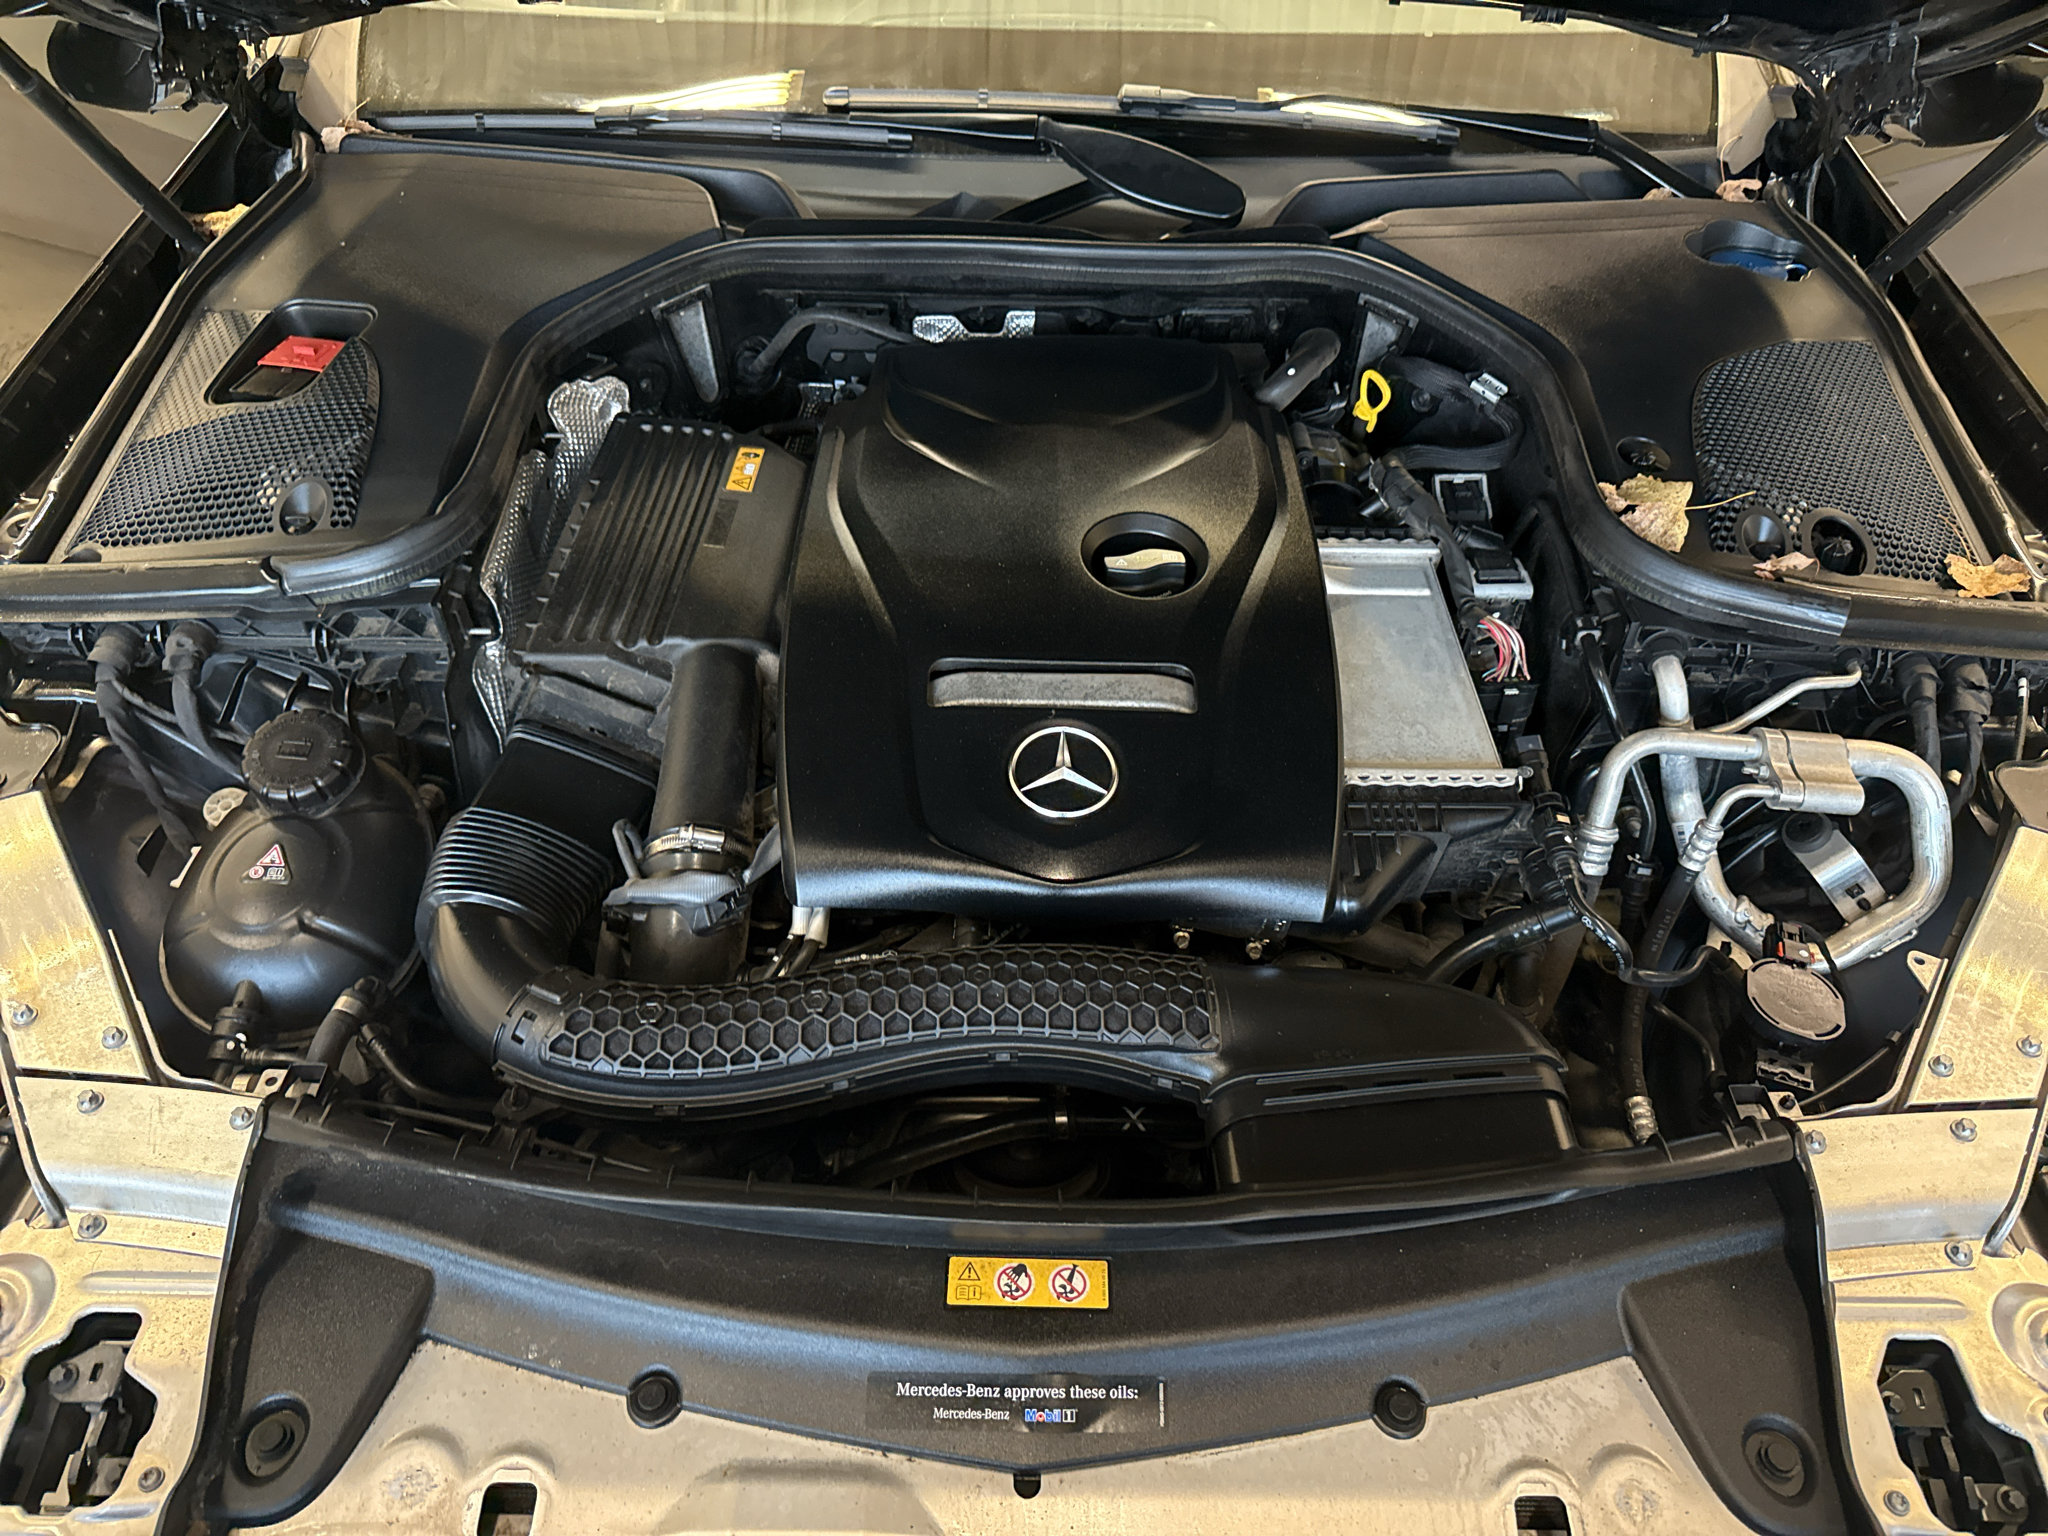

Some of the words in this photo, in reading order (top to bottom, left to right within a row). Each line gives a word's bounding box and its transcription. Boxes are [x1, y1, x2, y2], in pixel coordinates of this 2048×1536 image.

[896, 1382, 1001, 1398] Mercedes-Benz
[1003, 1386, 1067, 1402] approves
[1069, 1384, 1106, 1399] these
[1109, 1384, 1139, 1399] oils:
[933, 1407, 1010, 1420] Mercedes-Benz
[1024, 1408, 1061, 1423] Mobil
